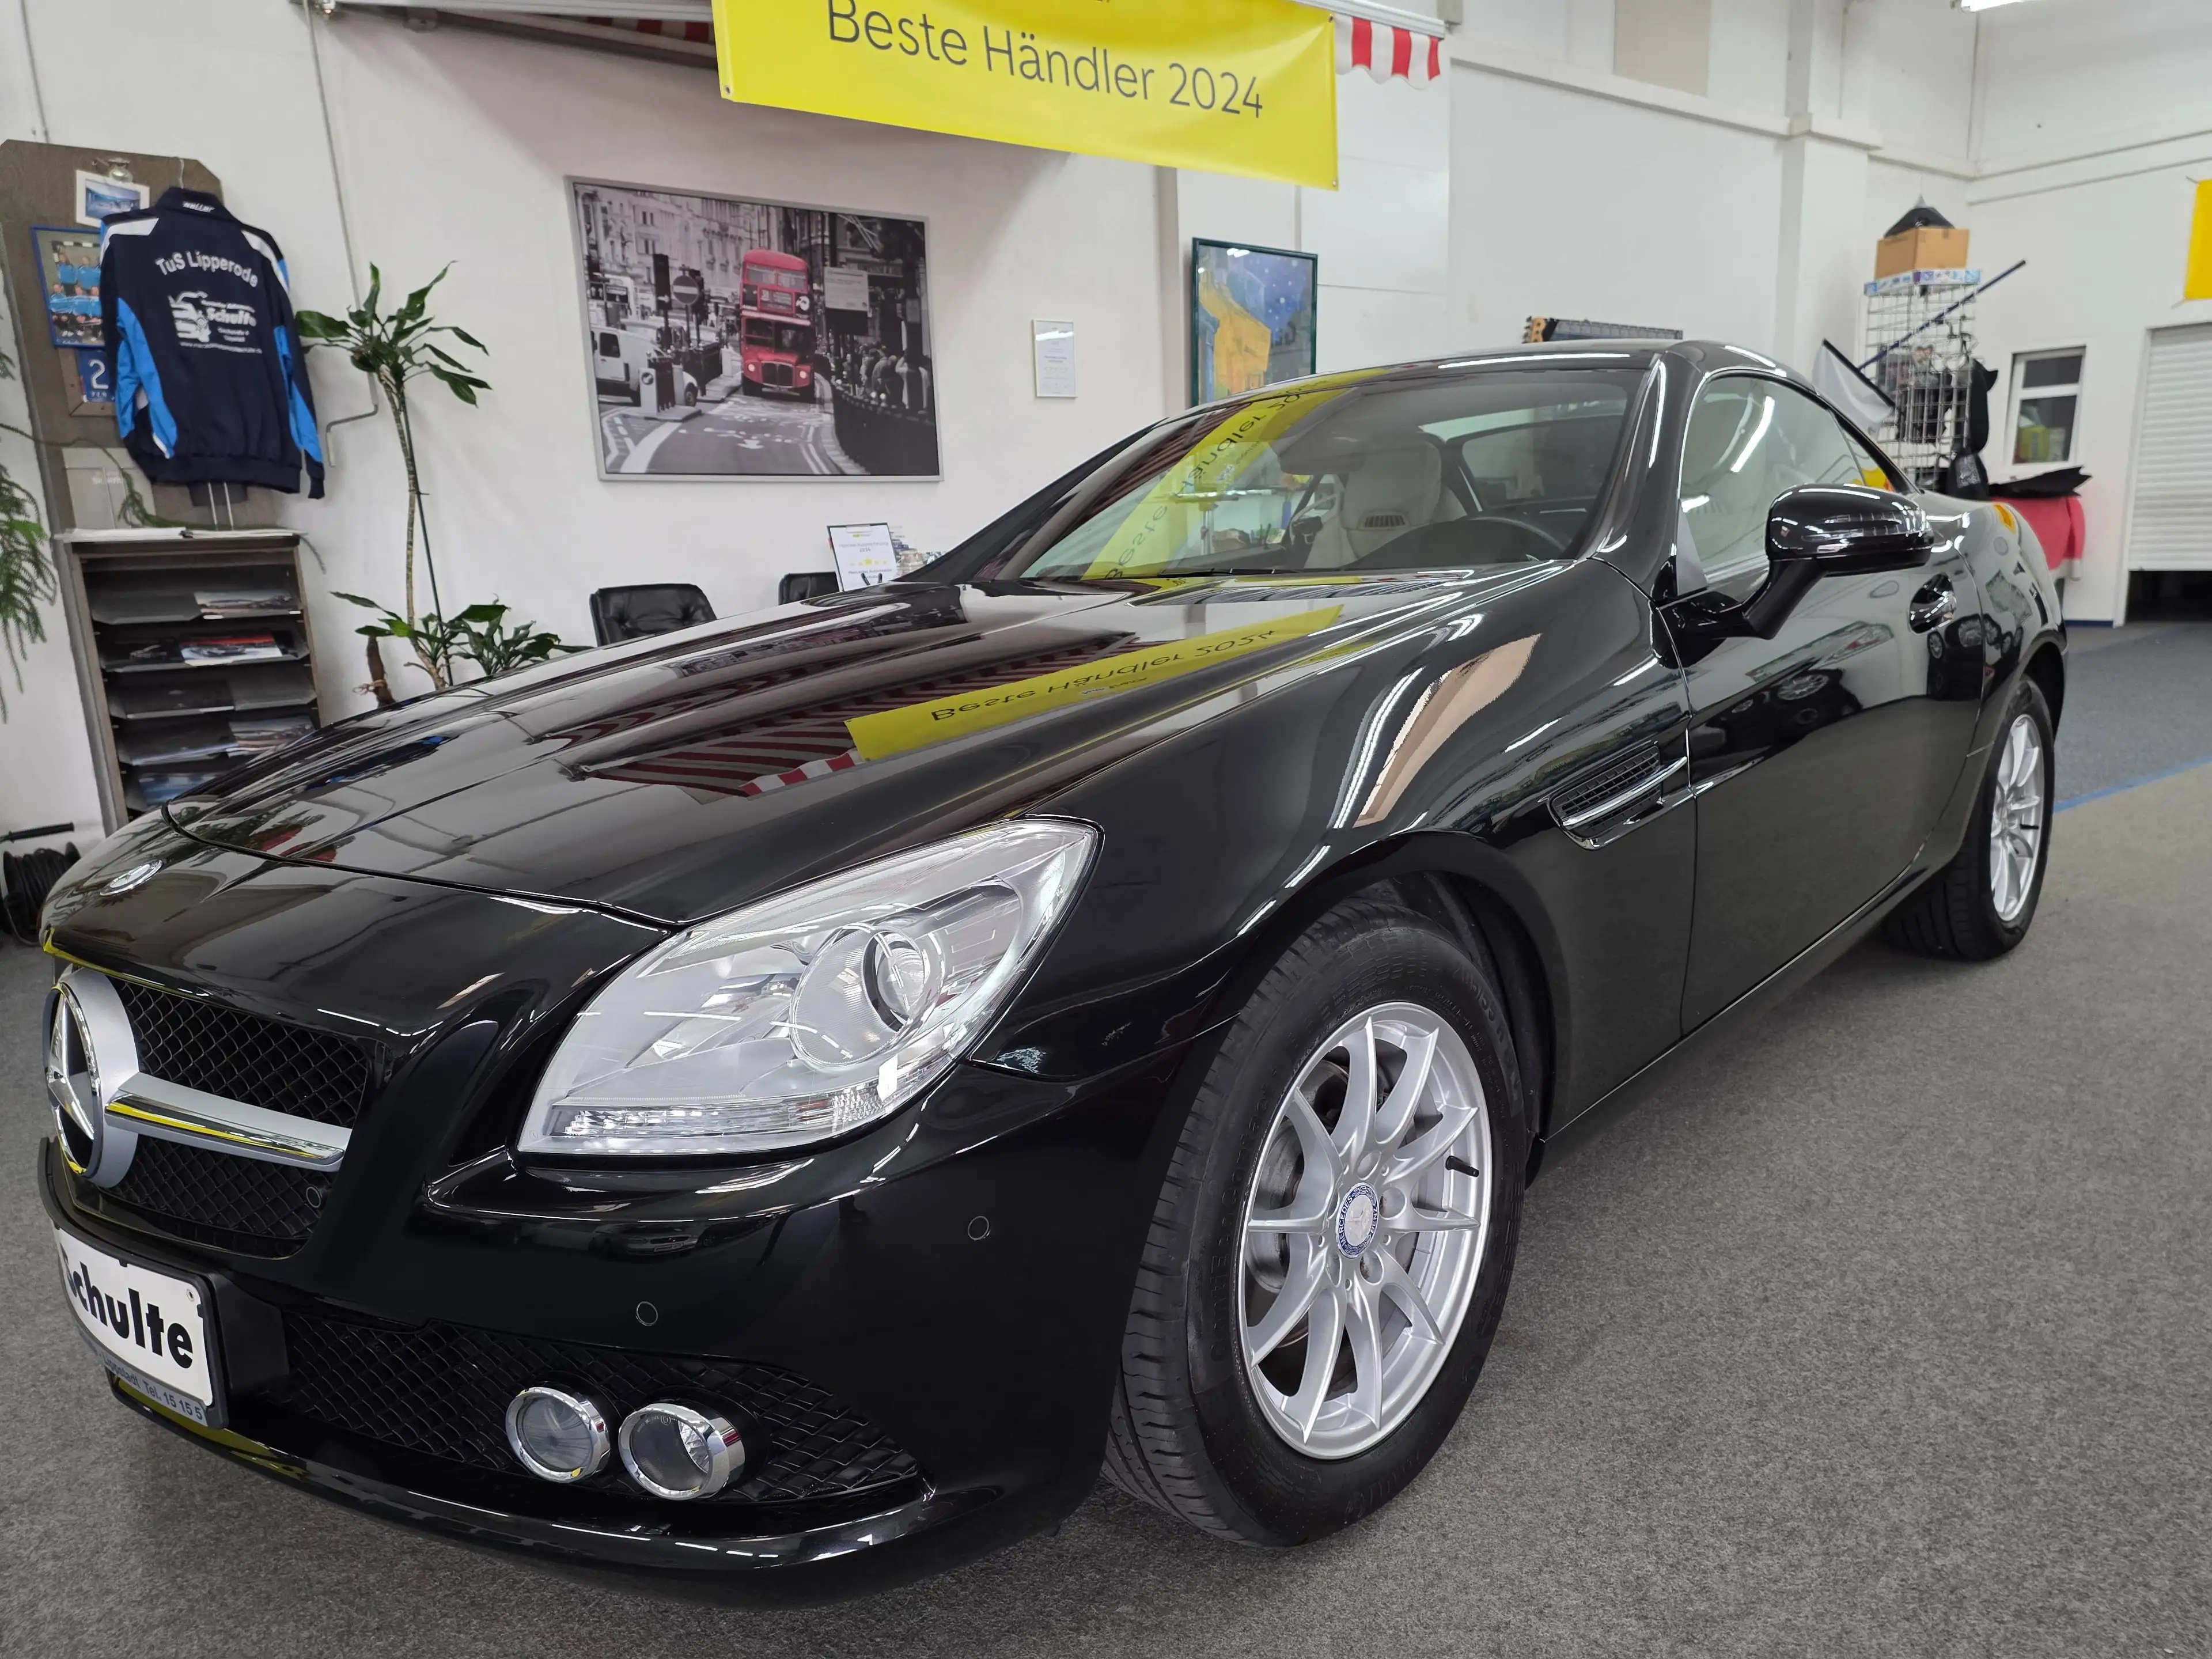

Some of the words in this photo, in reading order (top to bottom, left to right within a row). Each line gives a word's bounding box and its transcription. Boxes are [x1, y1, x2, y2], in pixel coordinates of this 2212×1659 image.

[828, 0, 968, 66] Beste
[983, 25, 1155, 100] Händler
[1169, 62, 1263, 119] 2024
[156, 252, 185, 275] TuS
[185, 250, 258, 287] Lipperode
[1339, 1195, 1353, 1246] MERCEDES
[143, 1380, 162, 1401] Tel.
[164, 1392, 177, 1408] 15
[179, 1399, 193, 1415] 15
